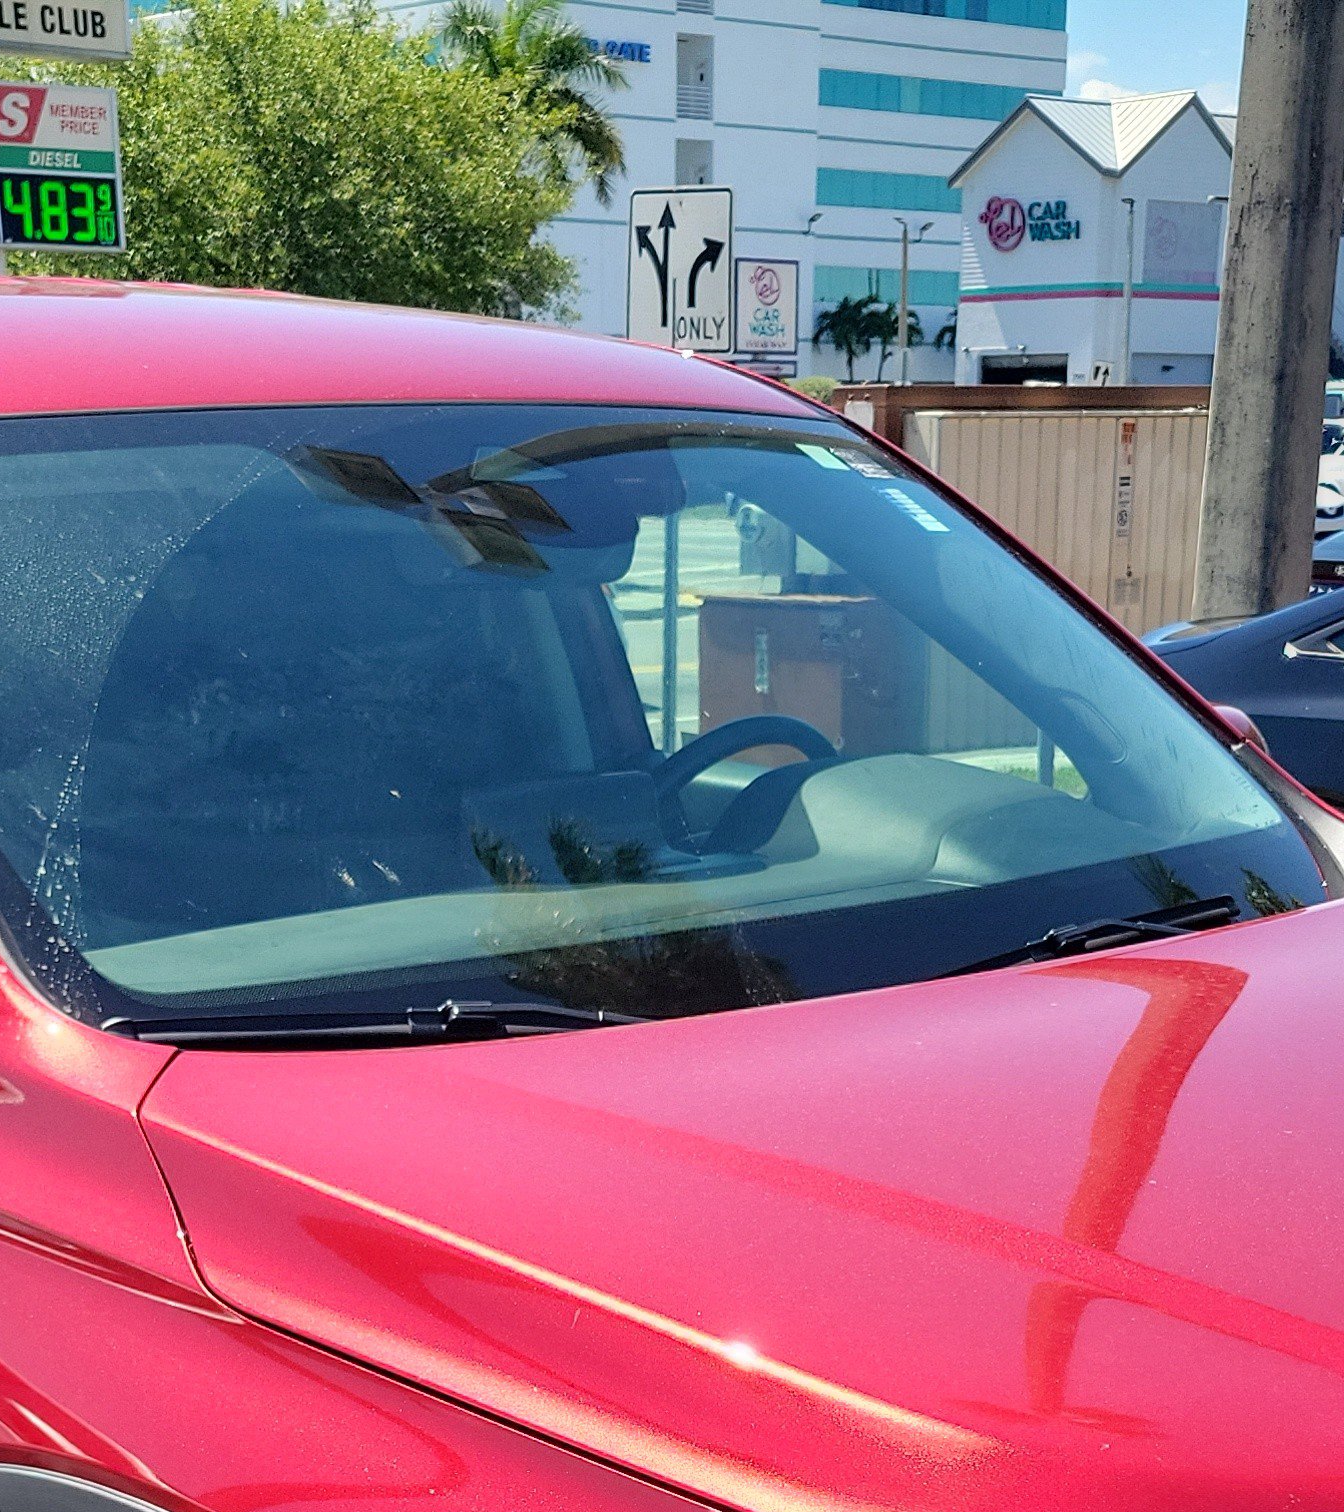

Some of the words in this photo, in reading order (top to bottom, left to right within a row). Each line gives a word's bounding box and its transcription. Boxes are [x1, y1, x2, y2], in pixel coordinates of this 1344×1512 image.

[41, 5, 106, 38] CLUB
[50, 104, 107, 120] MEMBER
[60, 120, 101, 135] PRICE
[29, 151, 82, 169] DIESEL
[1028, 200, 1066, 221] CAR
[1029, 220, 1080, 241] WASH
[753, 308, 780, 322] CAR
[677, 316, 725, 340] ONLY
[749, 321, 785, 337] WASH
